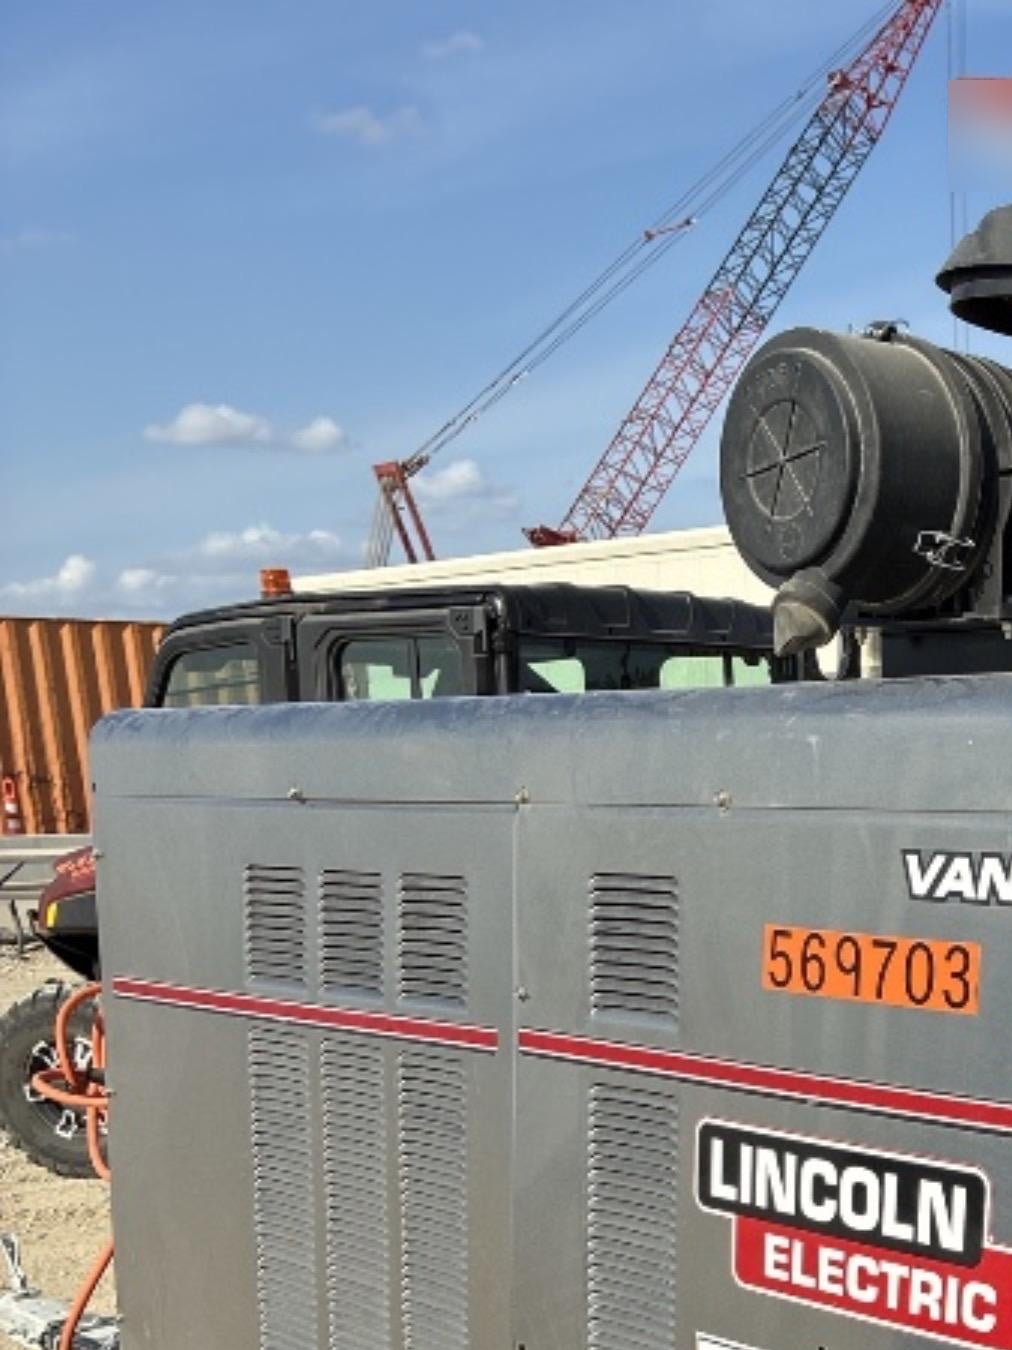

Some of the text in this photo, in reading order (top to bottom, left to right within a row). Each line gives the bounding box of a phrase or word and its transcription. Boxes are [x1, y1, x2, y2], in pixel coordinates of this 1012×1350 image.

[767, 929, 973, 1010] 569703
[709, 1136, 968, 1253] LINCOLN
[763, 1232, 998, 1333] ELECTRIC
